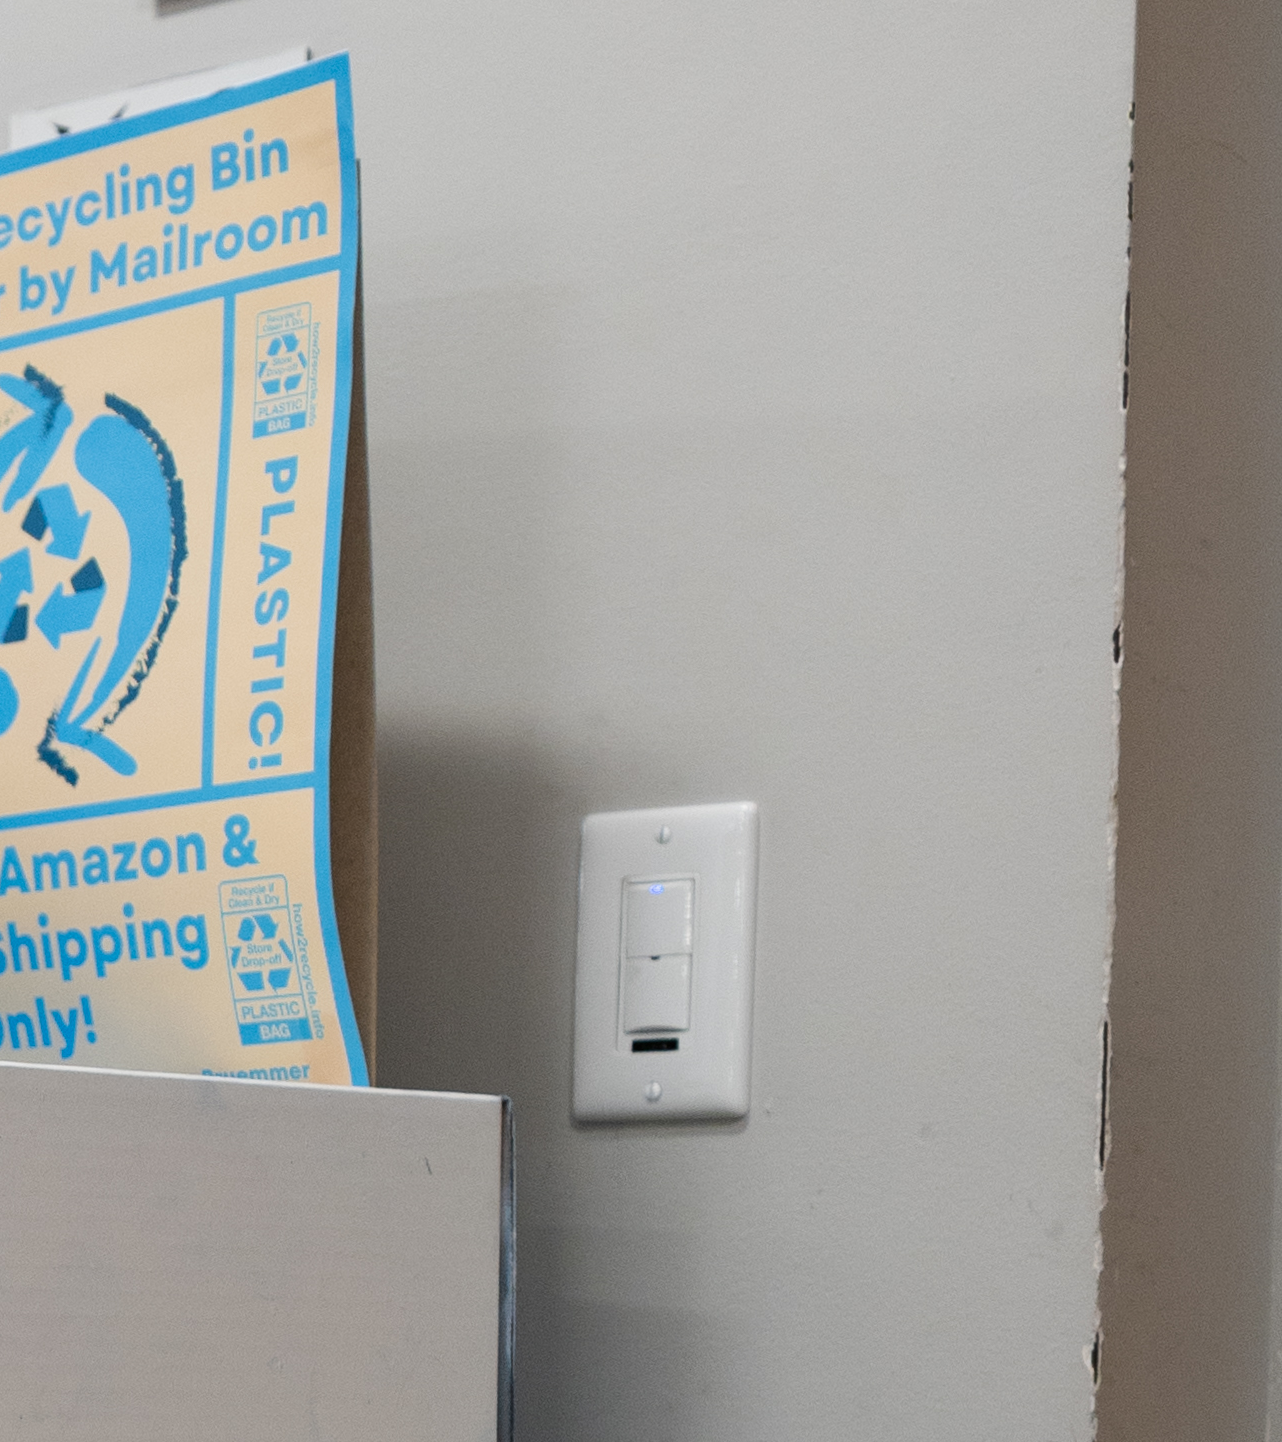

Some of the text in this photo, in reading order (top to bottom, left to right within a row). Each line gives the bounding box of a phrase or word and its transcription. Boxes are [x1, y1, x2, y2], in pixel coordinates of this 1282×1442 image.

[210, 129, 289, 190] Bin
[20, 266, 75, 315] by
[90, 200, 329, 293] Mailroom
[268, 418, 291, 432] BAG
[247, 455, 299, 771] PLASTIC!
[223, 814, 260, 868] &
[242, 1002, 300, 1020] PLASTIC
[259, 1024, 290, 1040] BAG
